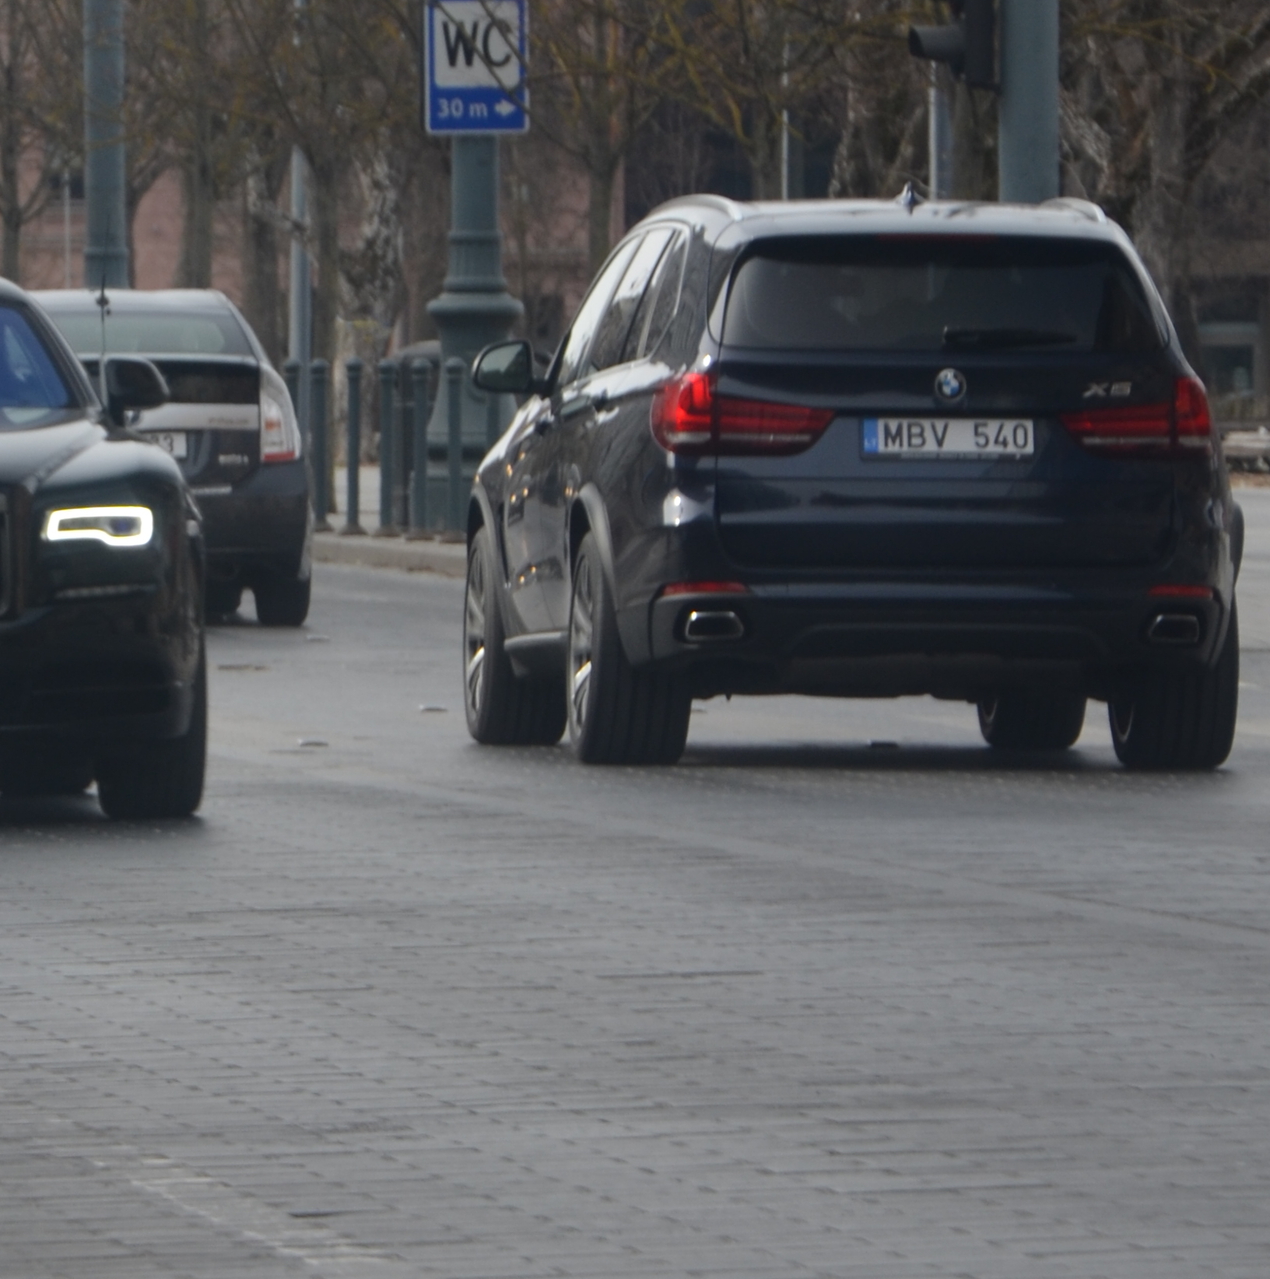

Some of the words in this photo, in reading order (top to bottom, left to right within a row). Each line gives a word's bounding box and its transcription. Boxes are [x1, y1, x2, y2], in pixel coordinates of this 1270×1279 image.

[442, 19, 512, 67] WC
[438, 98, 464, 119] 30
[469, 103, 488, 118] m
[882, 423, 950, 450] MBV
[974, 423, 1029, 449] 540
